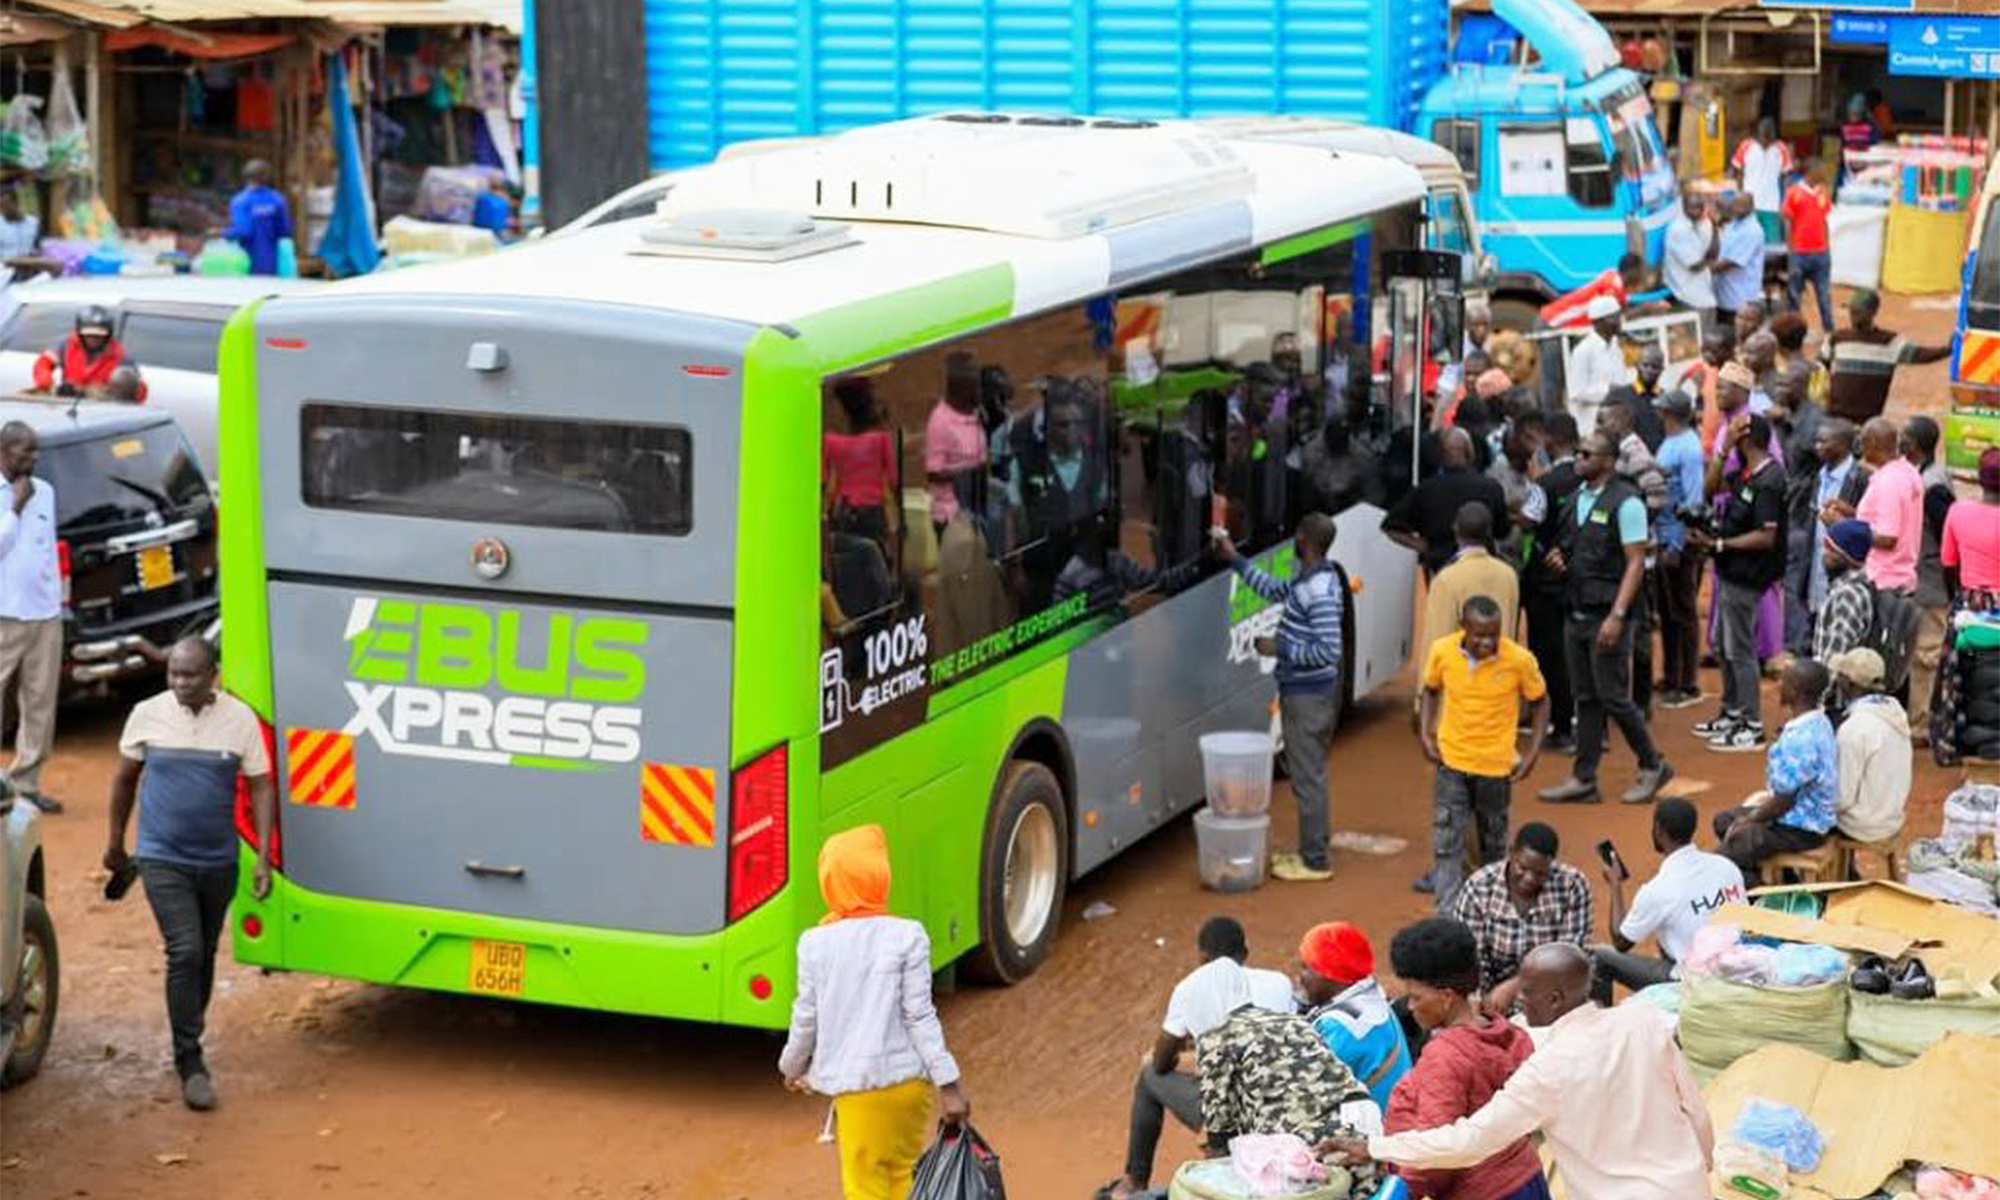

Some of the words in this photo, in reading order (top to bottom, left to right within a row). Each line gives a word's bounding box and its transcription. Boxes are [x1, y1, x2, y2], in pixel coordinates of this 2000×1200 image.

[344, 598, 648, 703] EBUS
[864, 613, 927, 679] 100%
[957, 627, 1015, 673] ELECTRIC
[1016, 591, 1089, 643] EXPERIENCE
[342, 681, 643, 763] XPRESS
[865, 664, 927, 706] ELECTRIC
[475, 967, 521, 992] 656H
